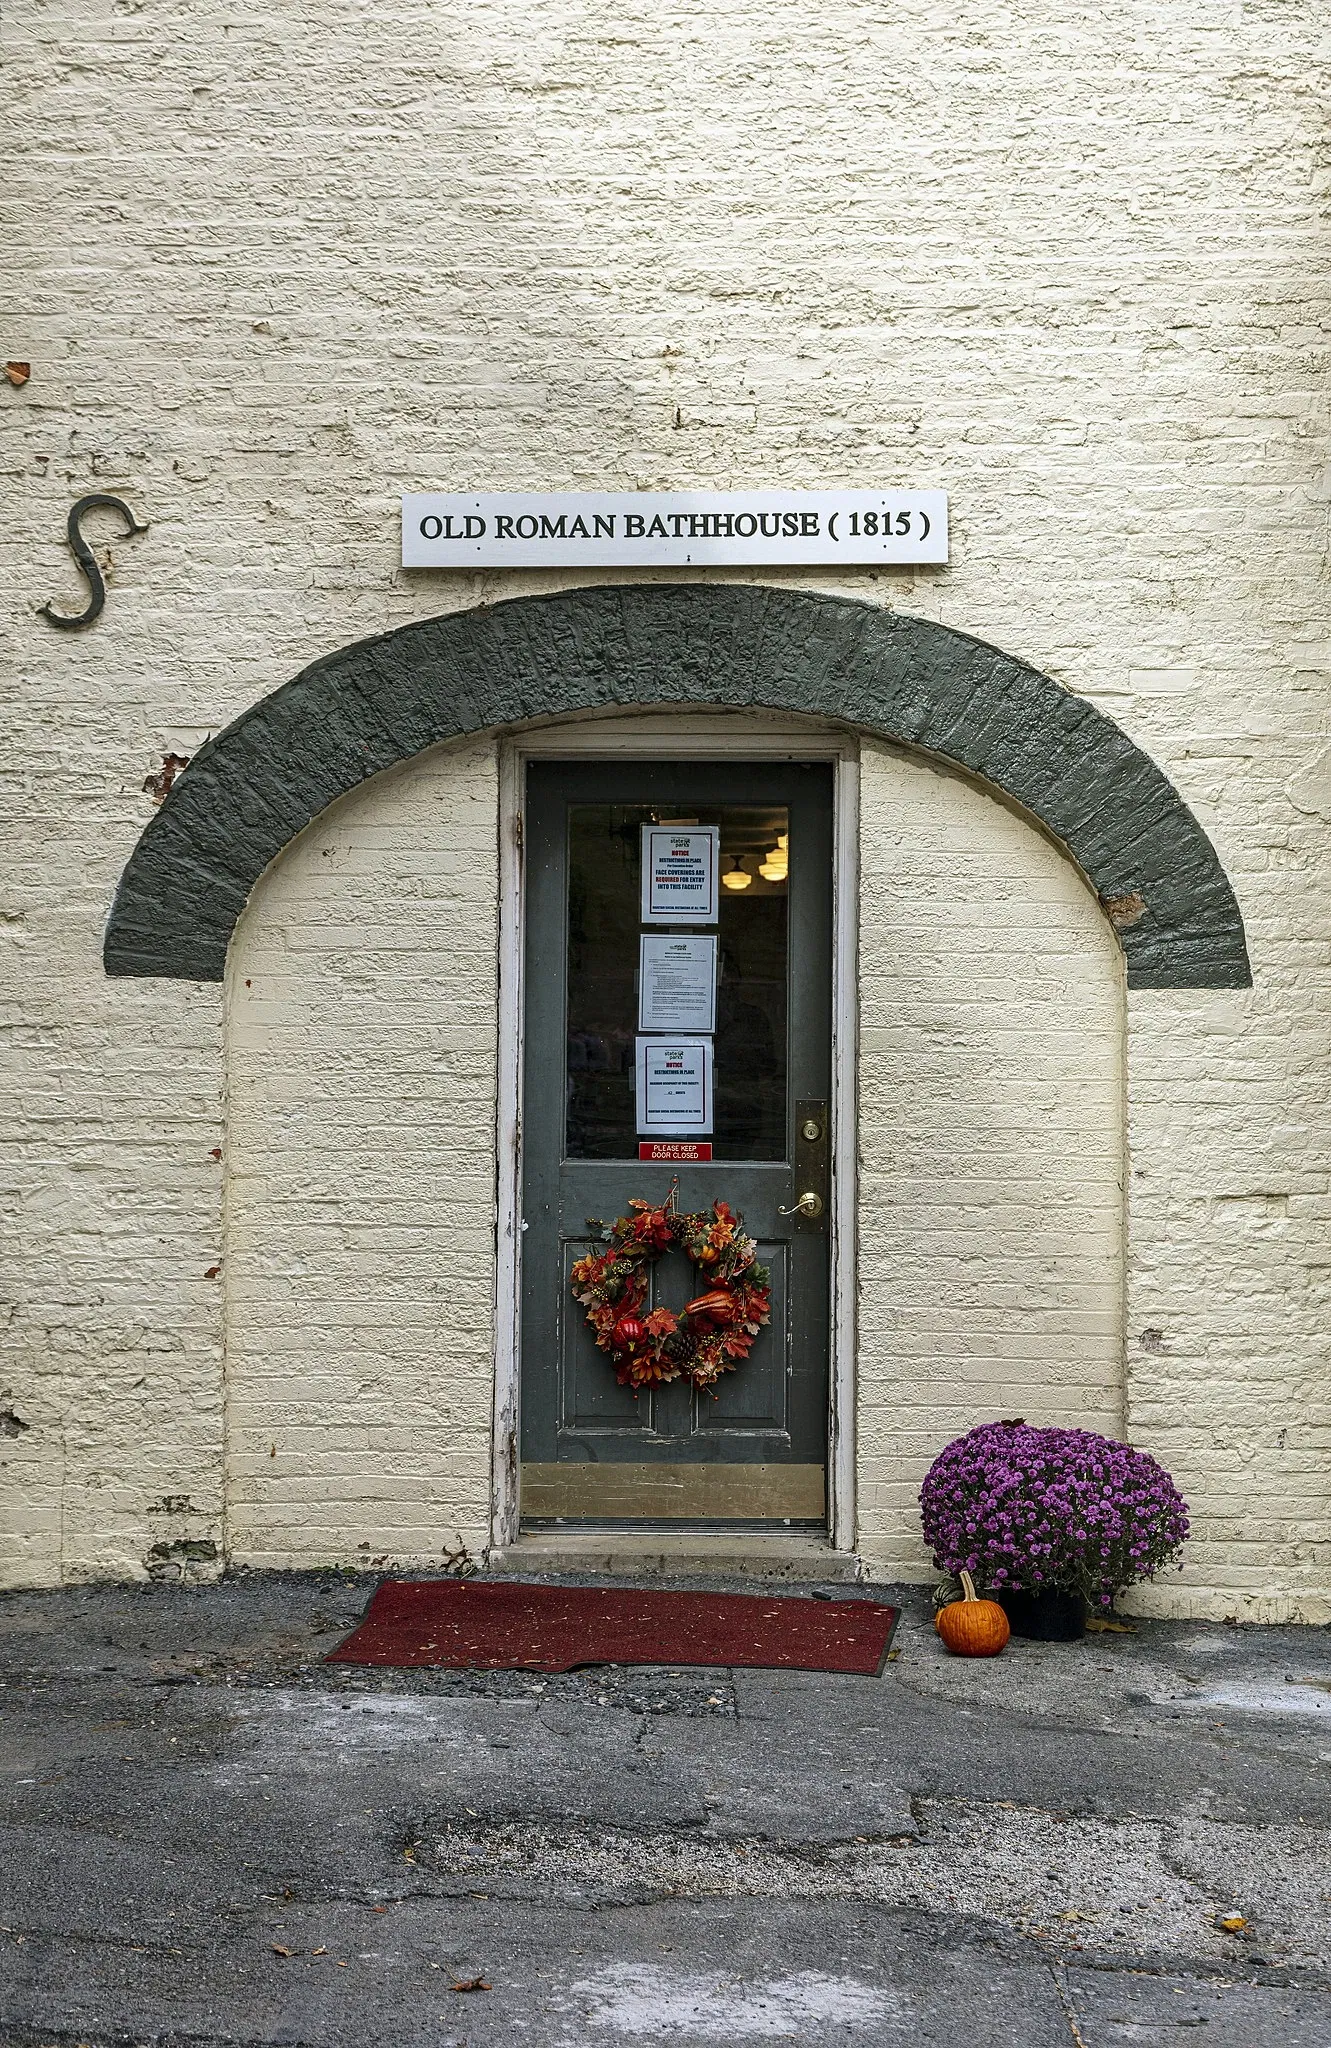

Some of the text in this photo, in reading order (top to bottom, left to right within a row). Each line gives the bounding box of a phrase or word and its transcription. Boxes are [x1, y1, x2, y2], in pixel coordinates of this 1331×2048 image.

[419, 514, 487, 540] OLD
[493, 514, 617, 539] ROMAN
[623, 512, 821, 539] BATHHOUSE
